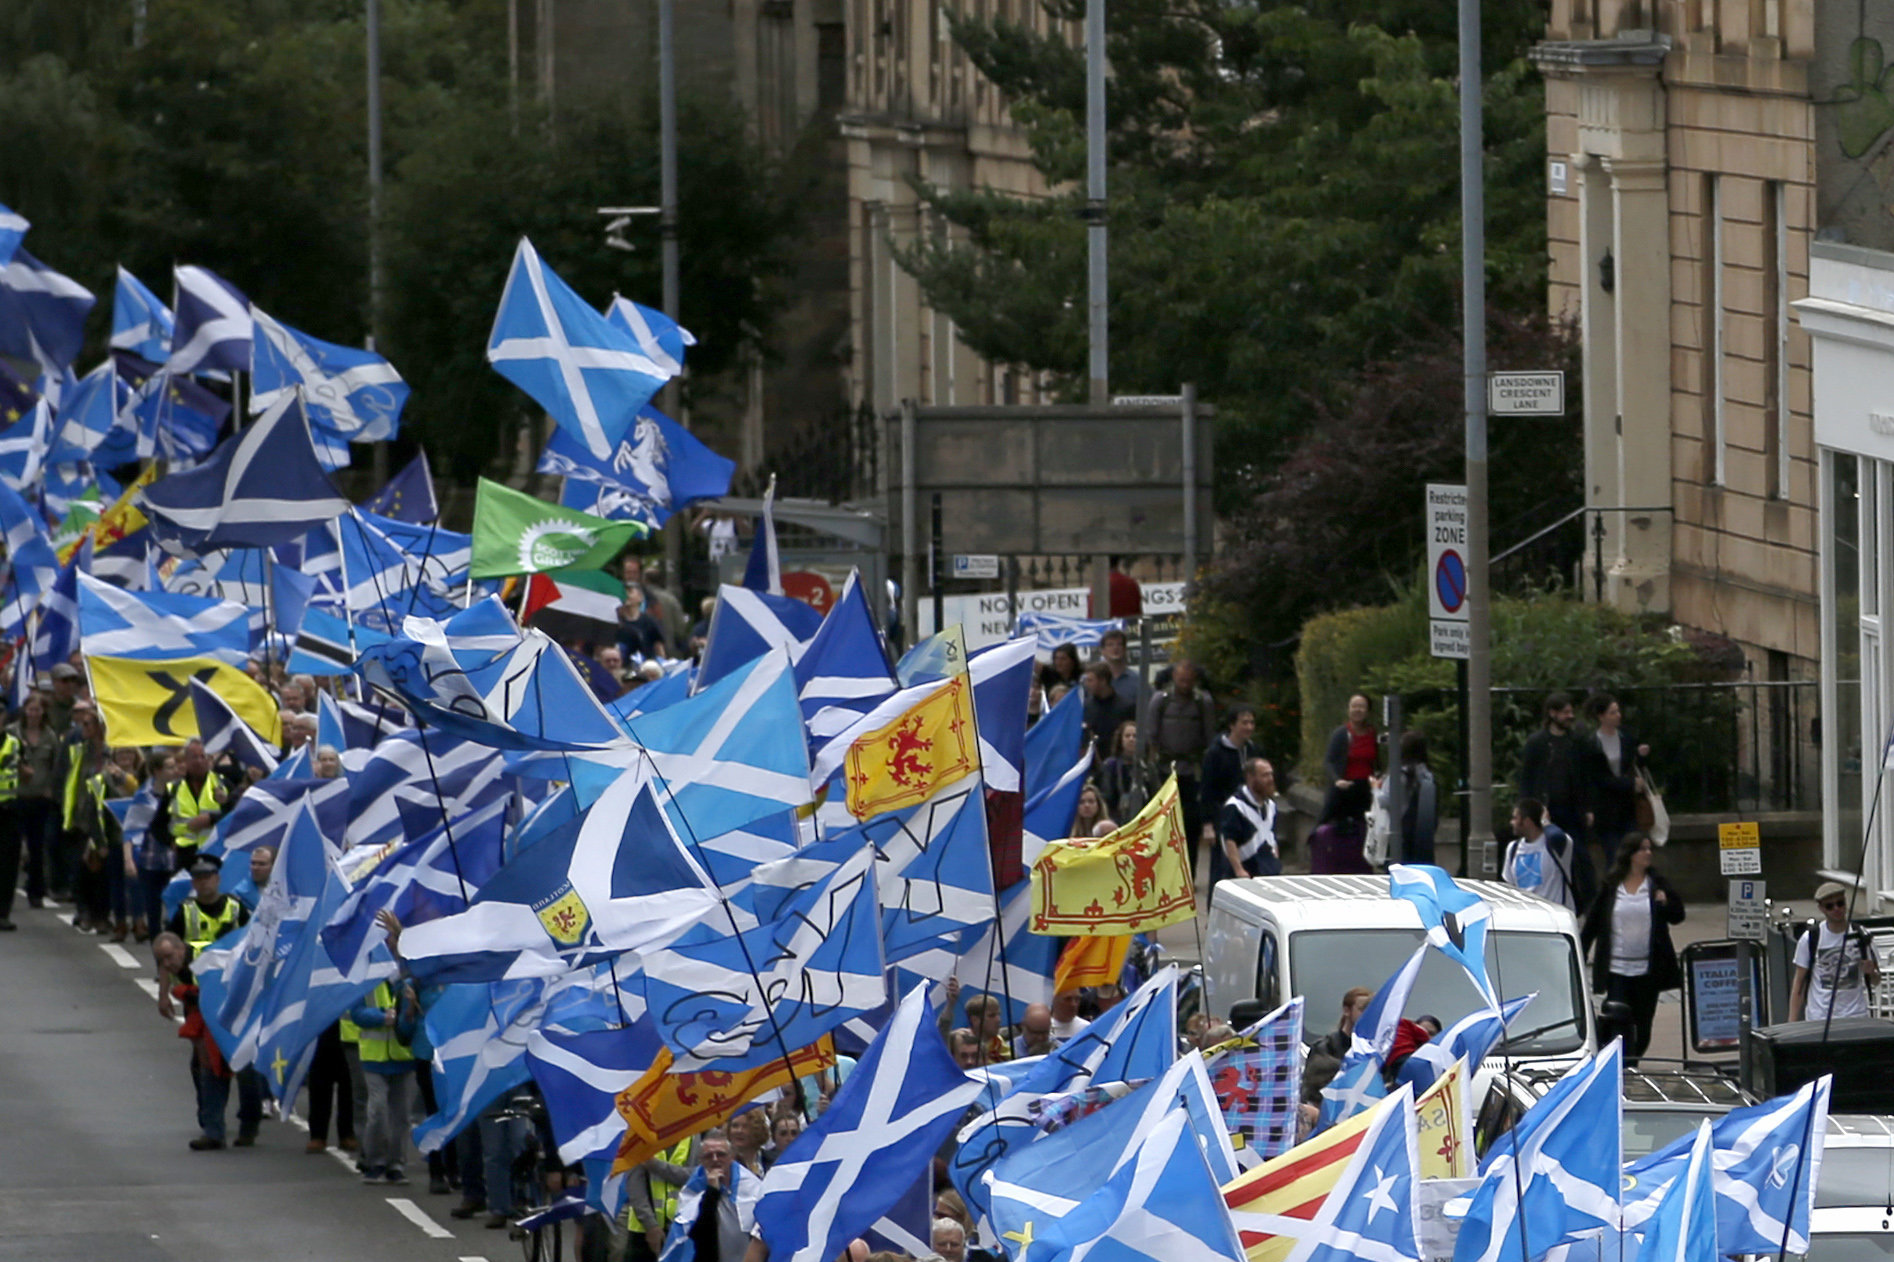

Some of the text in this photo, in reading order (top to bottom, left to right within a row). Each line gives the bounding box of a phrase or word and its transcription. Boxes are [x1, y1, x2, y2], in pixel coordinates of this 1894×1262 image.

[1494, 377, 1557, 388] LANSDOWNE
[1499, 388, 1552, 398] CRESCENT
[1513, 399, 1539, 409] LANE
[1429, 490, 1466, 505] Restricte
[1434, 508, 1465, 525] parking
[1434, 527, 1465, 544] ZONE
[1031, 594, 1080, 612] OPEN
[1700, 970, 1737, 979] ITALIA
